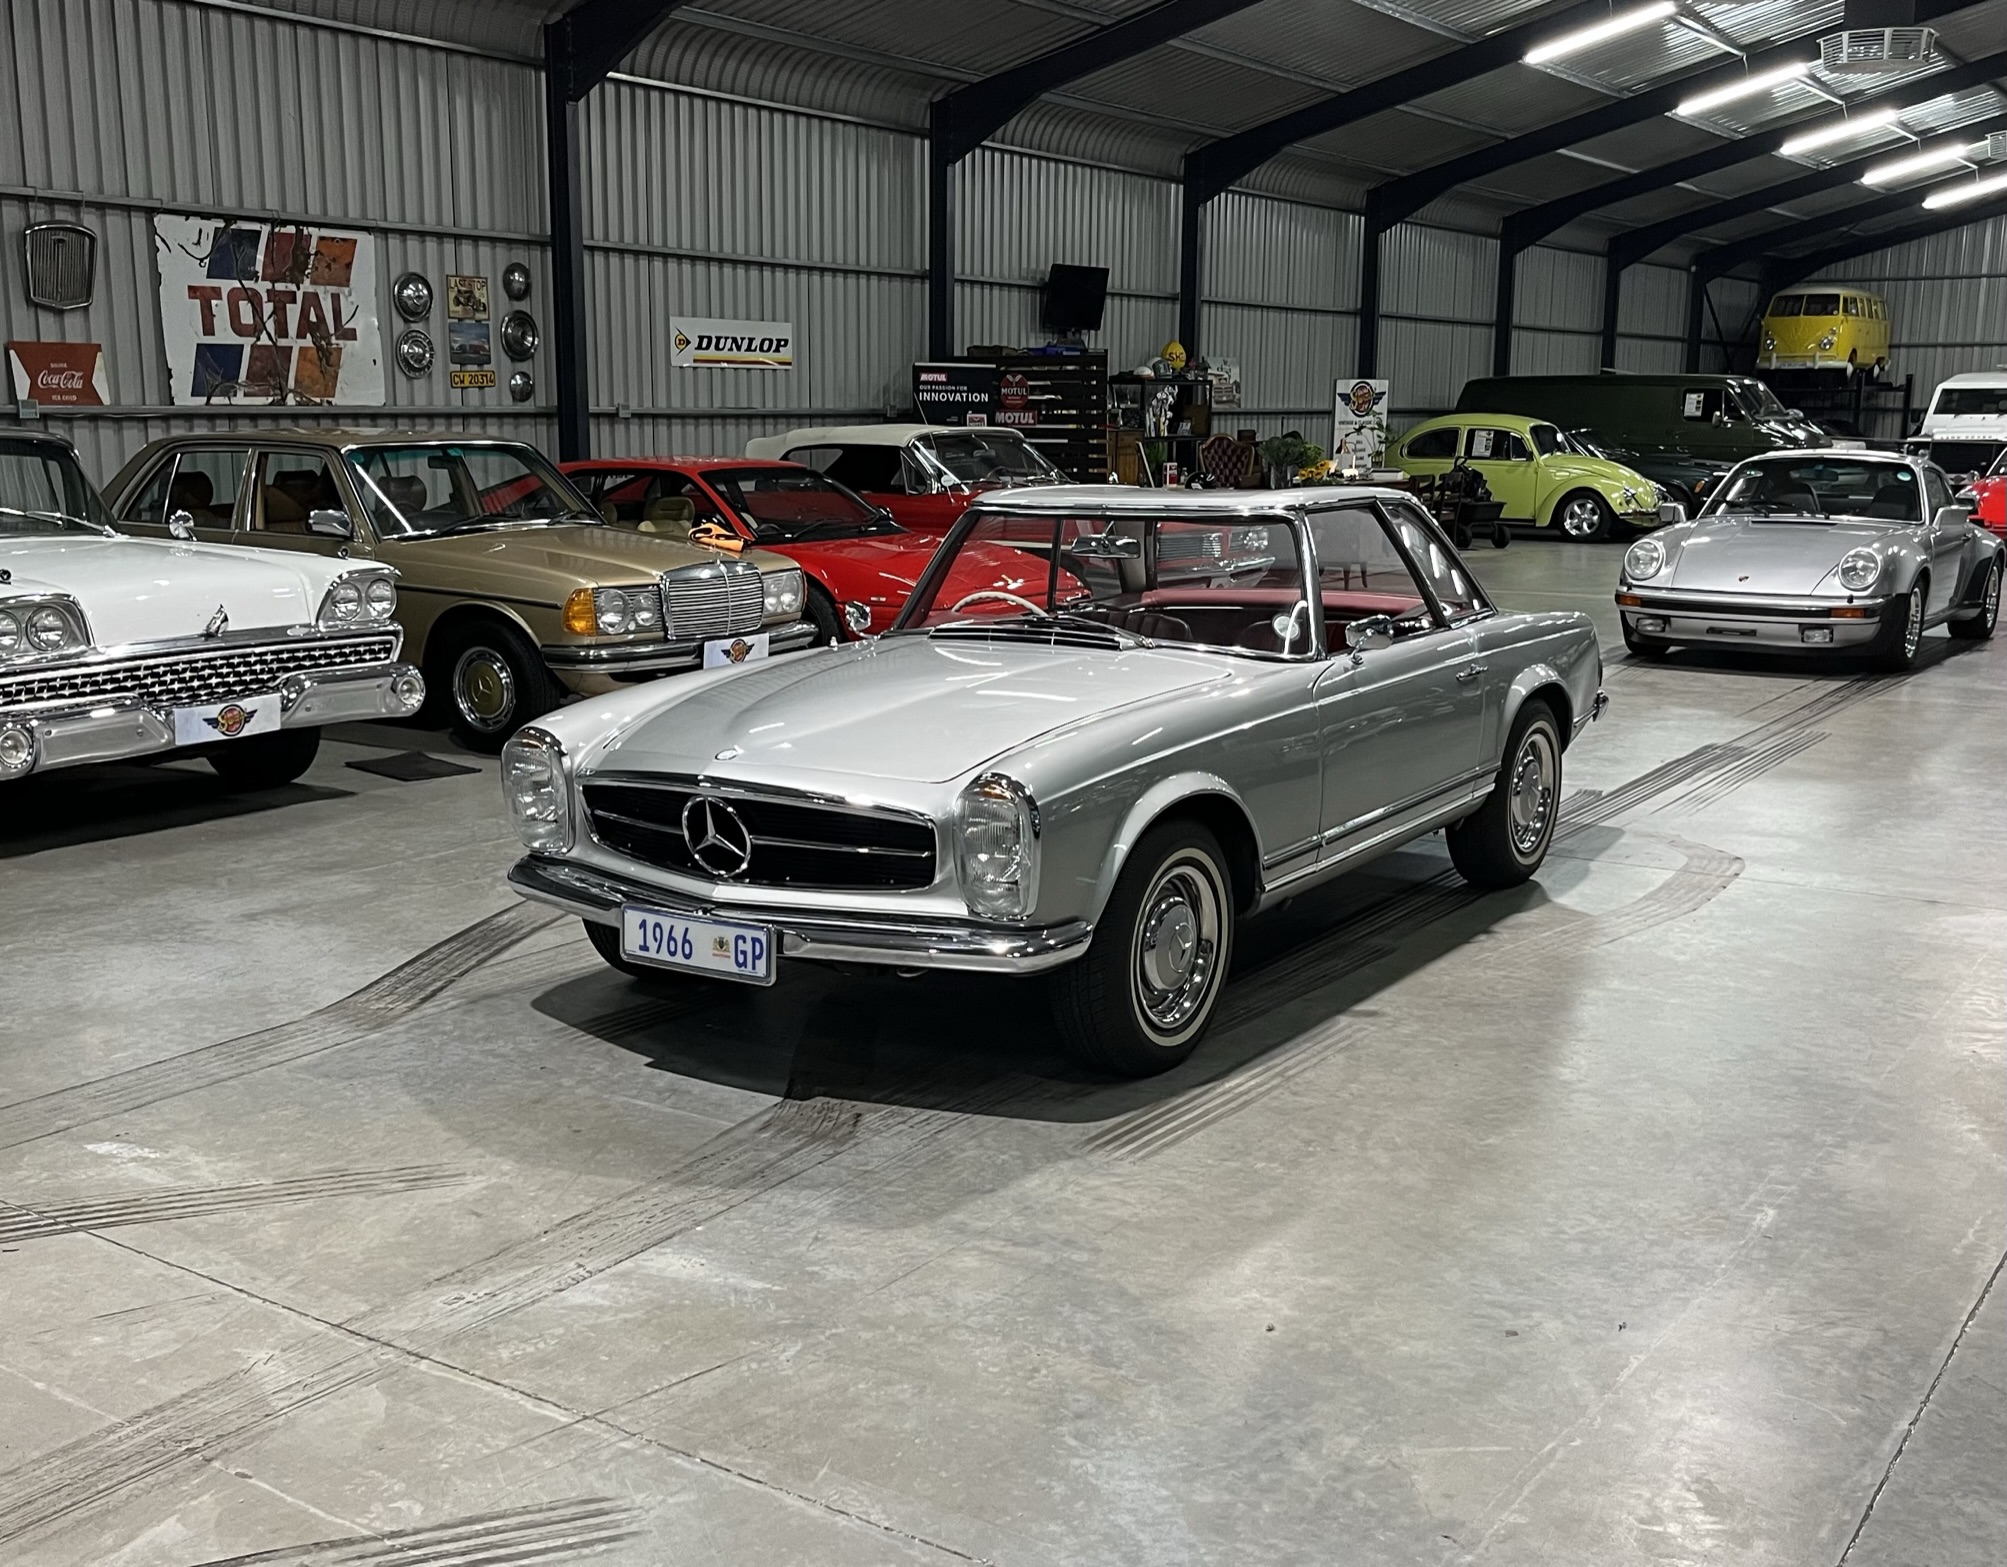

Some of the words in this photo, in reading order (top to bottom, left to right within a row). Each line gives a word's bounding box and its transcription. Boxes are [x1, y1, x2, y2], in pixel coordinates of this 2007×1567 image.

[449, 278, 466, 289] LAST
[467, 279, 486, 291] STOP
[187, 284, 358, 341] TOTAL
[694, 335, 789, 353] DUNLOP
[452, 374, 465, 385] CW
[468, 373, 495, 385] 20314
[920, 373, 947, 382] MOTUL
[919, 391, 989, 403] INNOVATION
[1001, 386, 1027, 396] MOTUL
[994, 411, 1035, 425] MOTUL
[638, 918, 693, 960] 1966
[734, 934, 764, 971] GP
